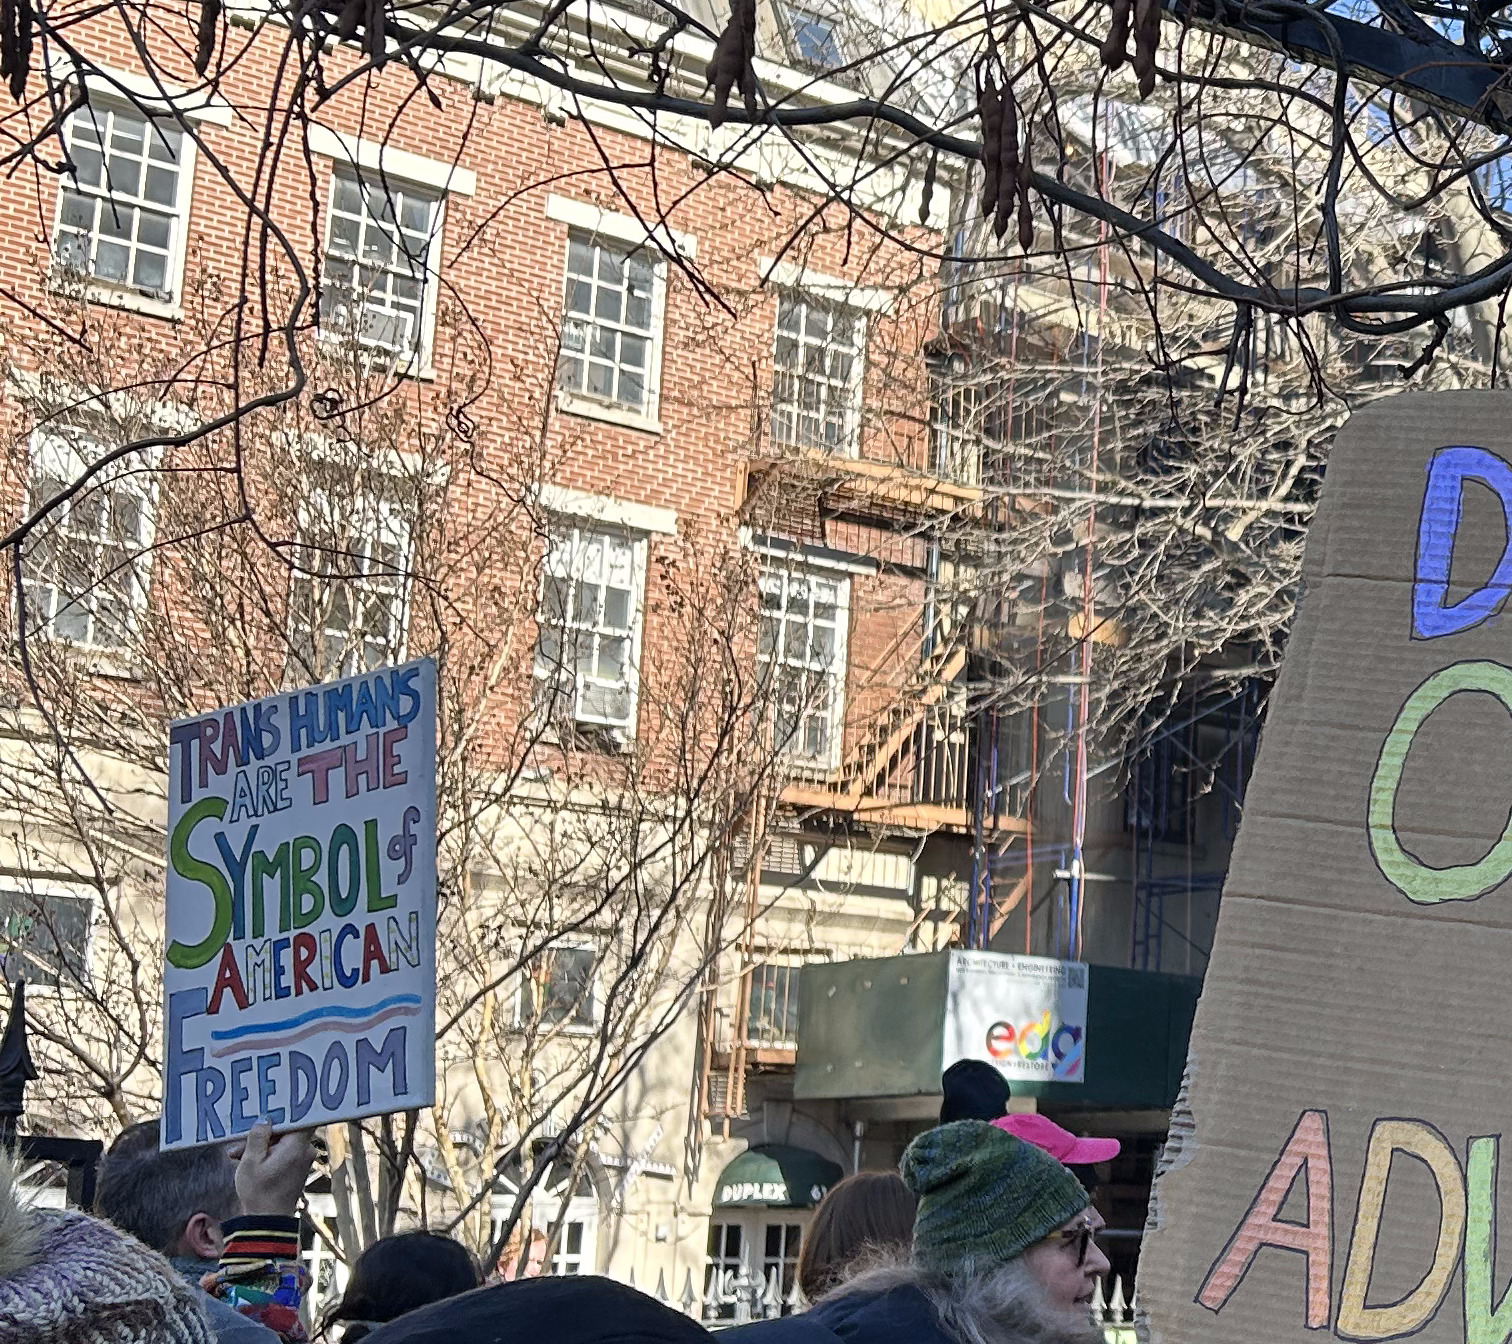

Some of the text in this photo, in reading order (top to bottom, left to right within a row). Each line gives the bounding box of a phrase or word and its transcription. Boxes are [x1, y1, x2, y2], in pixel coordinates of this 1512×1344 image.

[170, 667, 420, 804] TRANS HUMANS
[228, 724, 408, 824] ARE THE
[166, 796, 420, 970] SYMBOL of
[207, 912, 420, 1015] AMERICAN
[165, 987, 408, 1144] FREEDOM
[721, 1182, 787, 1203] DUPLEX
